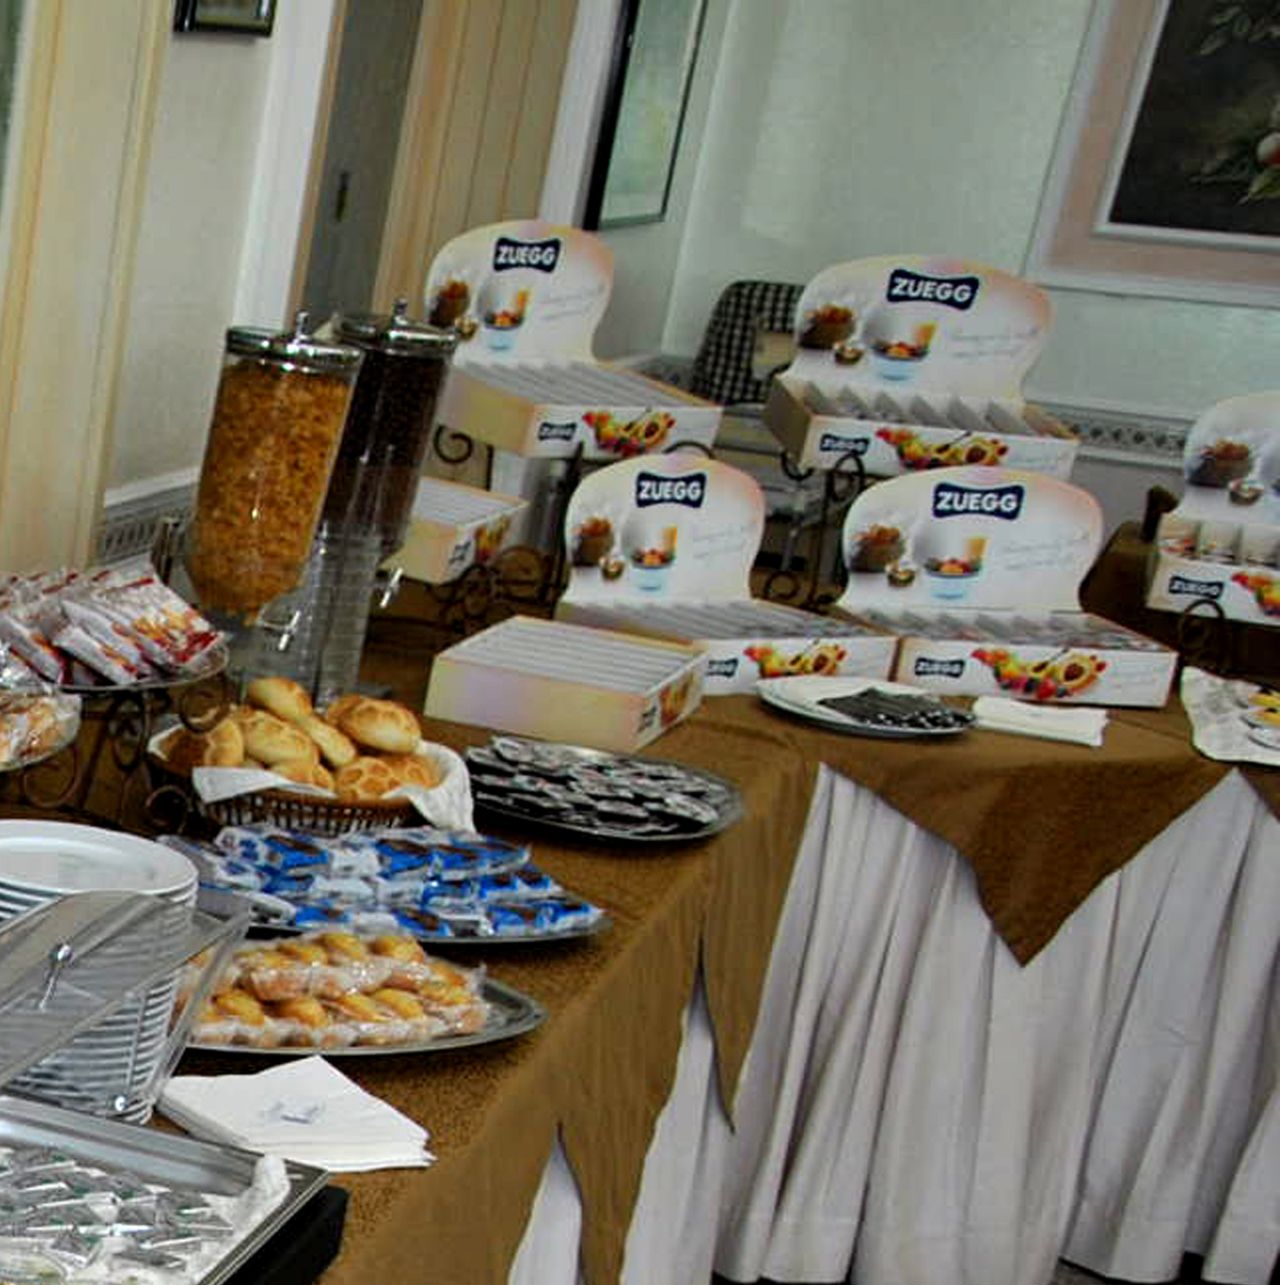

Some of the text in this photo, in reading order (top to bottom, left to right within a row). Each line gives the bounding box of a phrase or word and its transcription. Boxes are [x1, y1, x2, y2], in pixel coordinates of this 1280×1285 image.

[496, 245, 555, 265] ZUEGG
[890, 277, 972, 302] ZUEGG
[639, 480, 702, 501] ZUEGG
[936, 490, 1017, 512] ZUEGG
